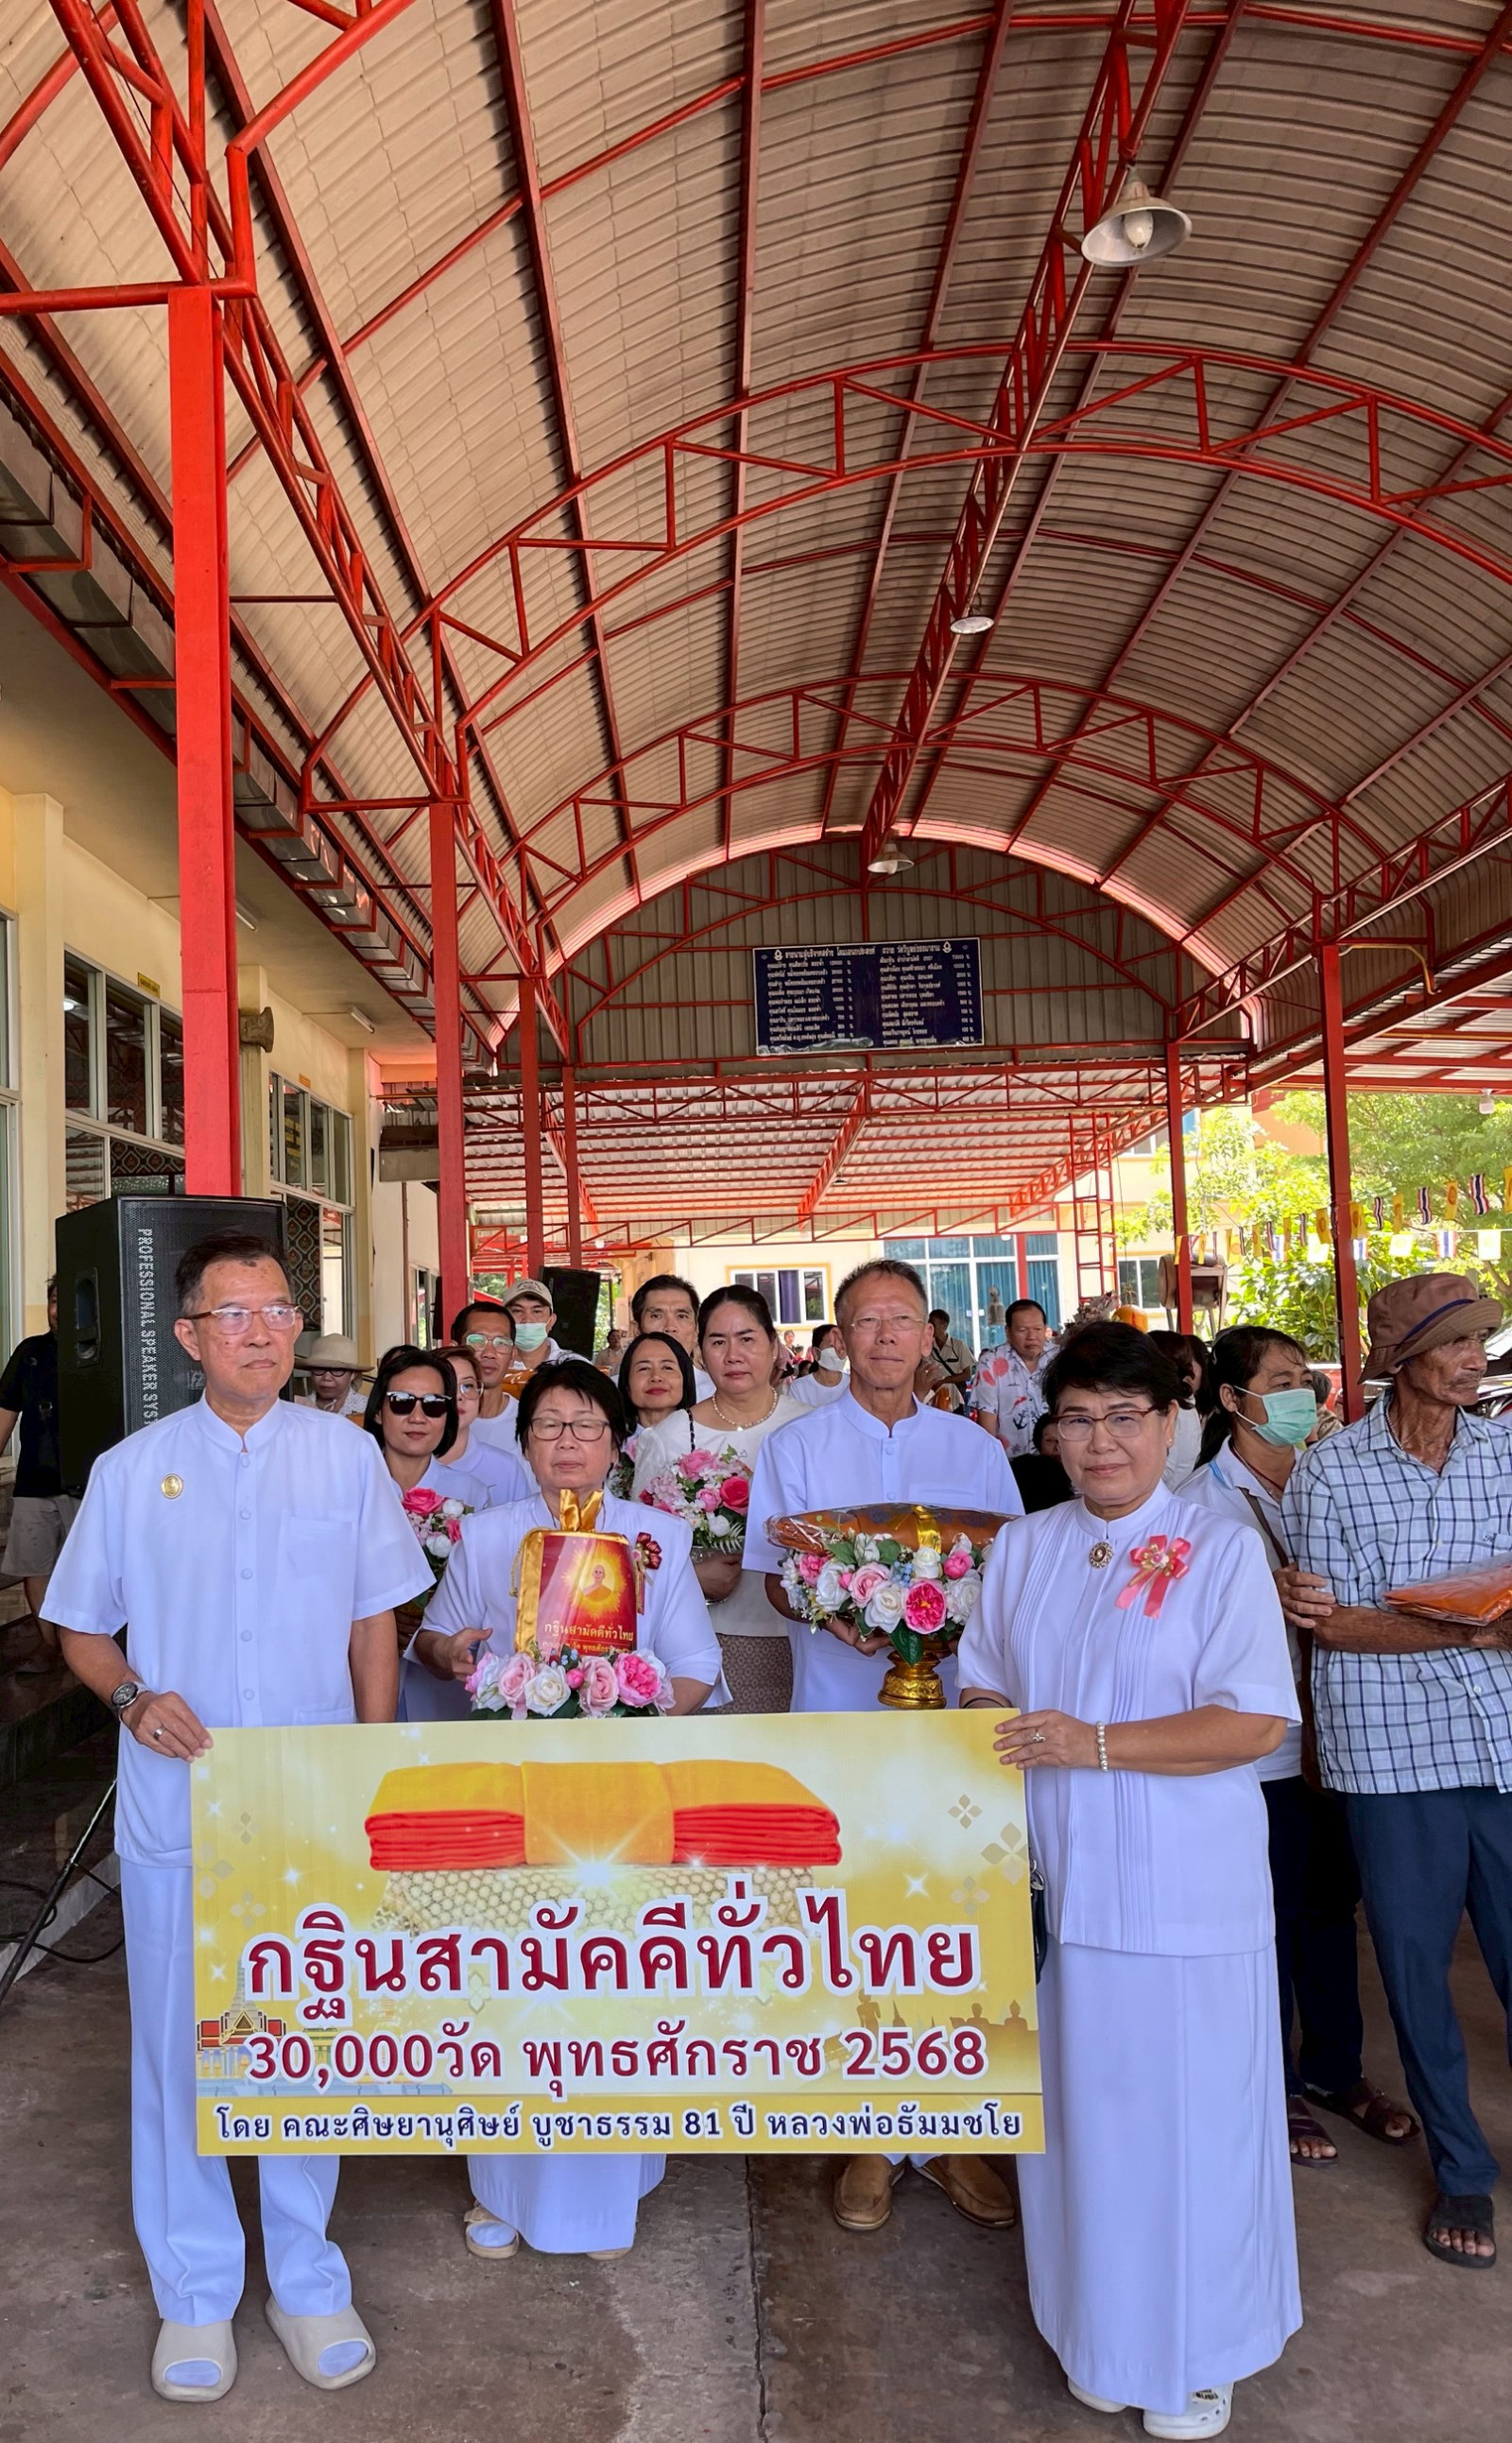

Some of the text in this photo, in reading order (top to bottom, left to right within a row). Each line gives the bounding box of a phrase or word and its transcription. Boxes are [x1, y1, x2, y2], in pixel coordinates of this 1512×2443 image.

[138, 1228, 156, 1328] PROFESSIONAL
[141, 1330, 157, 1390] SPEAKER
[544, 1620, 634, 1642] กฐินสามัคคีทั่วไทย
[248, 1881, 974, 2020] กฐินสามัคคีทั่วไทย
[249, 2019, 985, 2098] 30,000วัด พุทธศักราช 2568
[216, 2102, 1022, 2148] โดย คณะศิษยานุศิษย์ บูชาธรรม 81 ปี หลวงพ่อธัมมชโย
